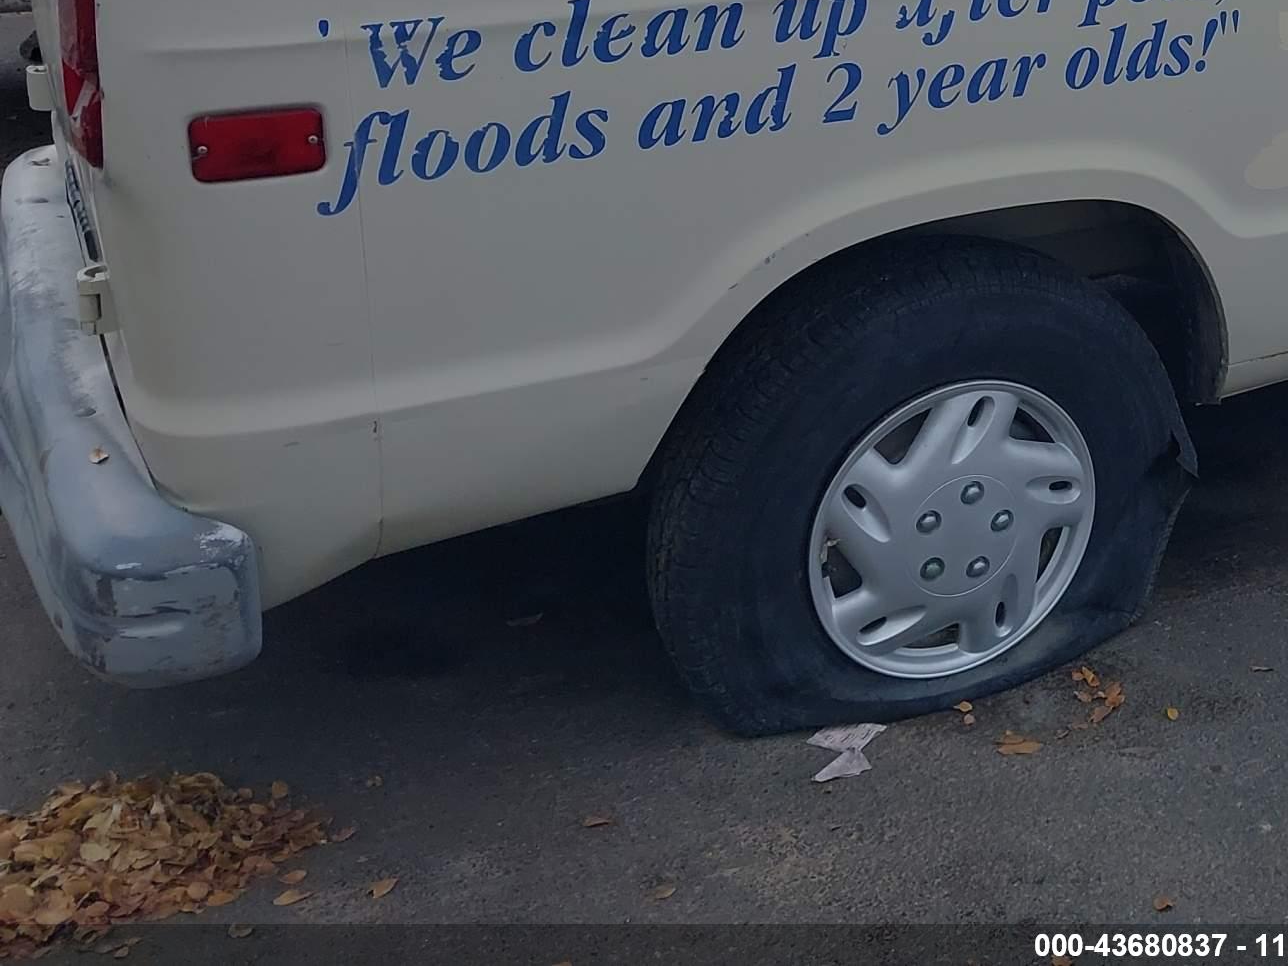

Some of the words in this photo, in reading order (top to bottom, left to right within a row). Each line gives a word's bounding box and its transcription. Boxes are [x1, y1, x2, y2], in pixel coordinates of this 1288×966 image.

[316, 89, 610, 217] floods
[637, 62, 798, 150] and
[821, 61, 863, 125] 2
[876, 52, 1048, 136] year
[1064, 8, 1240, 90] olds!"
